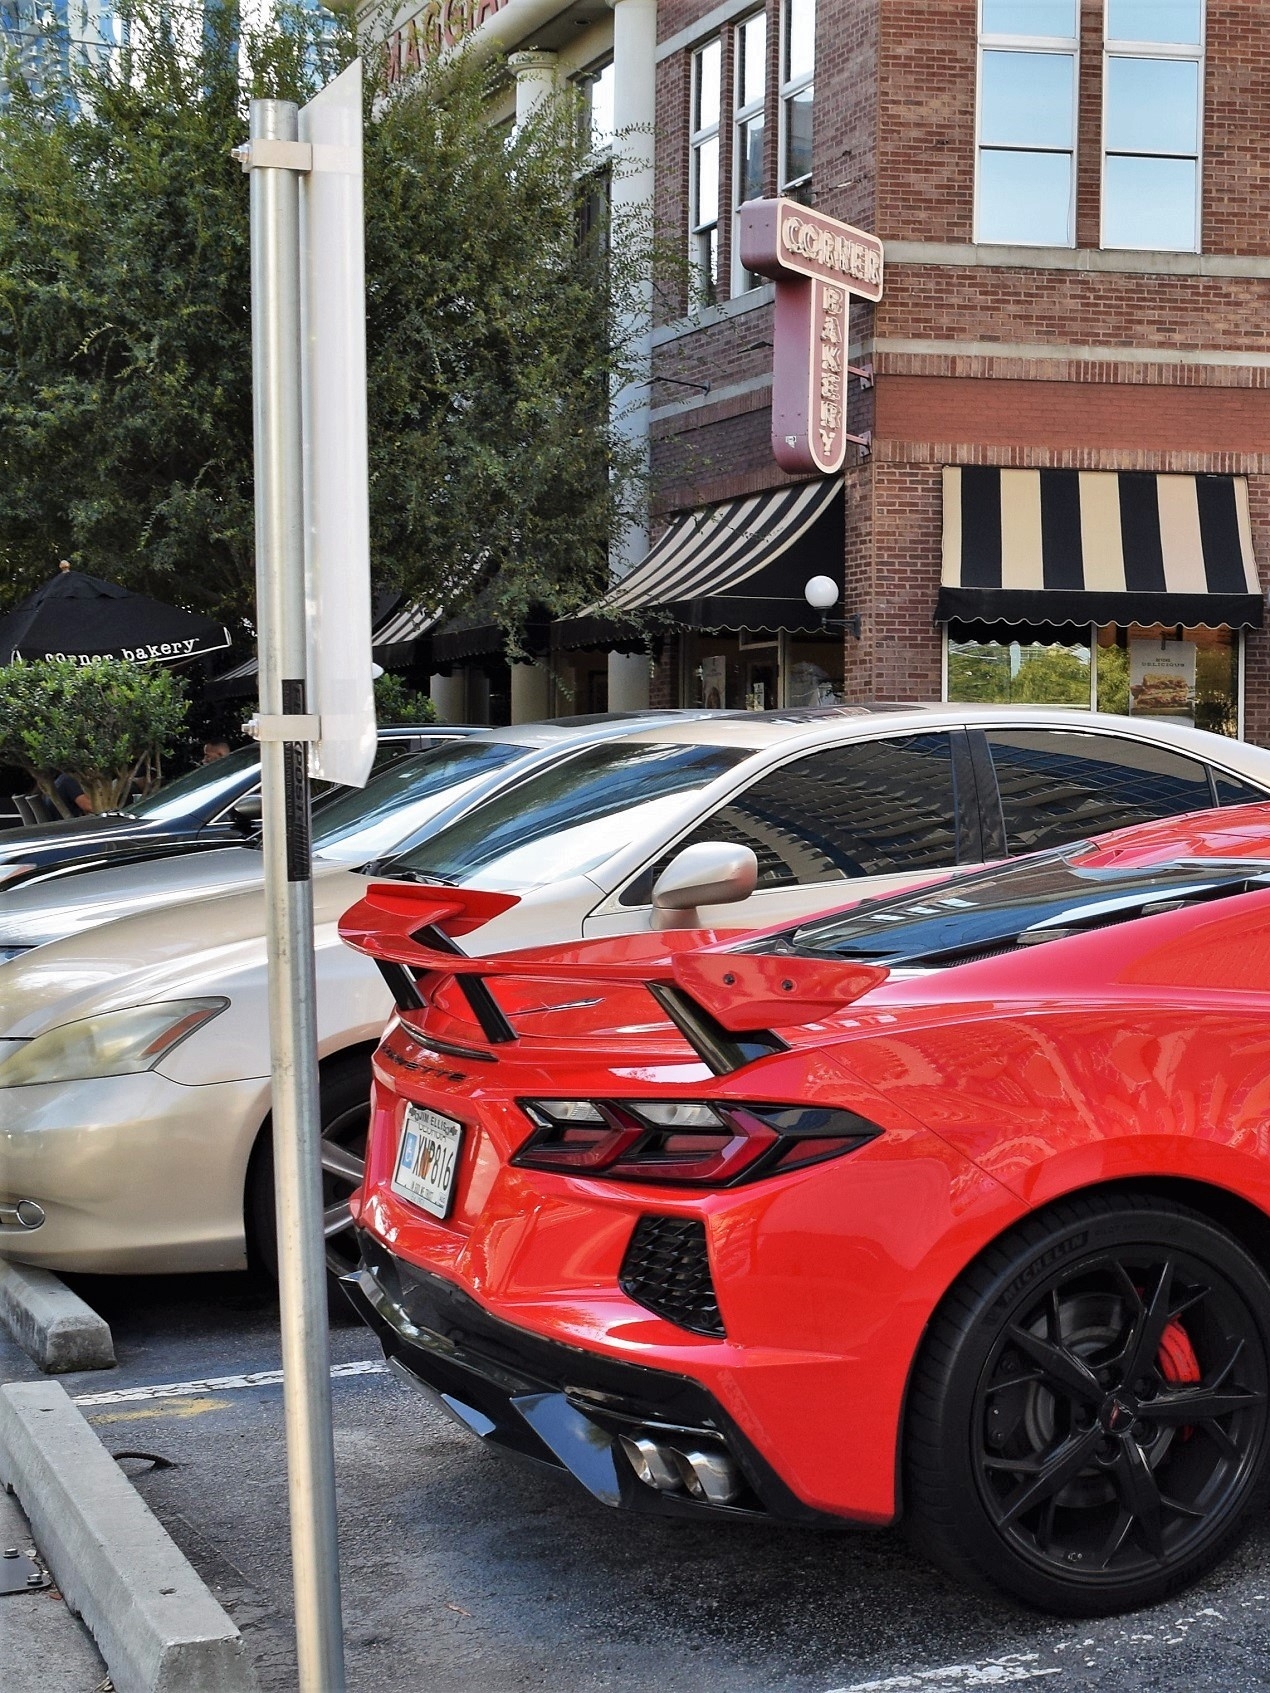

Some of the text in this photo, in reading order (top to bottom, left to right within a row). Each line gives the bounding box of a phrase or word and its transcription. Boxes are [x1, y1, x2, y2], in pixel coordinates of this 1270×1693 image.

[782, 217, 881, 284] CORNER
[820, 288, 842, 456] BAKERY
[1003, 1235, 1085, 1300] MICHELIN
